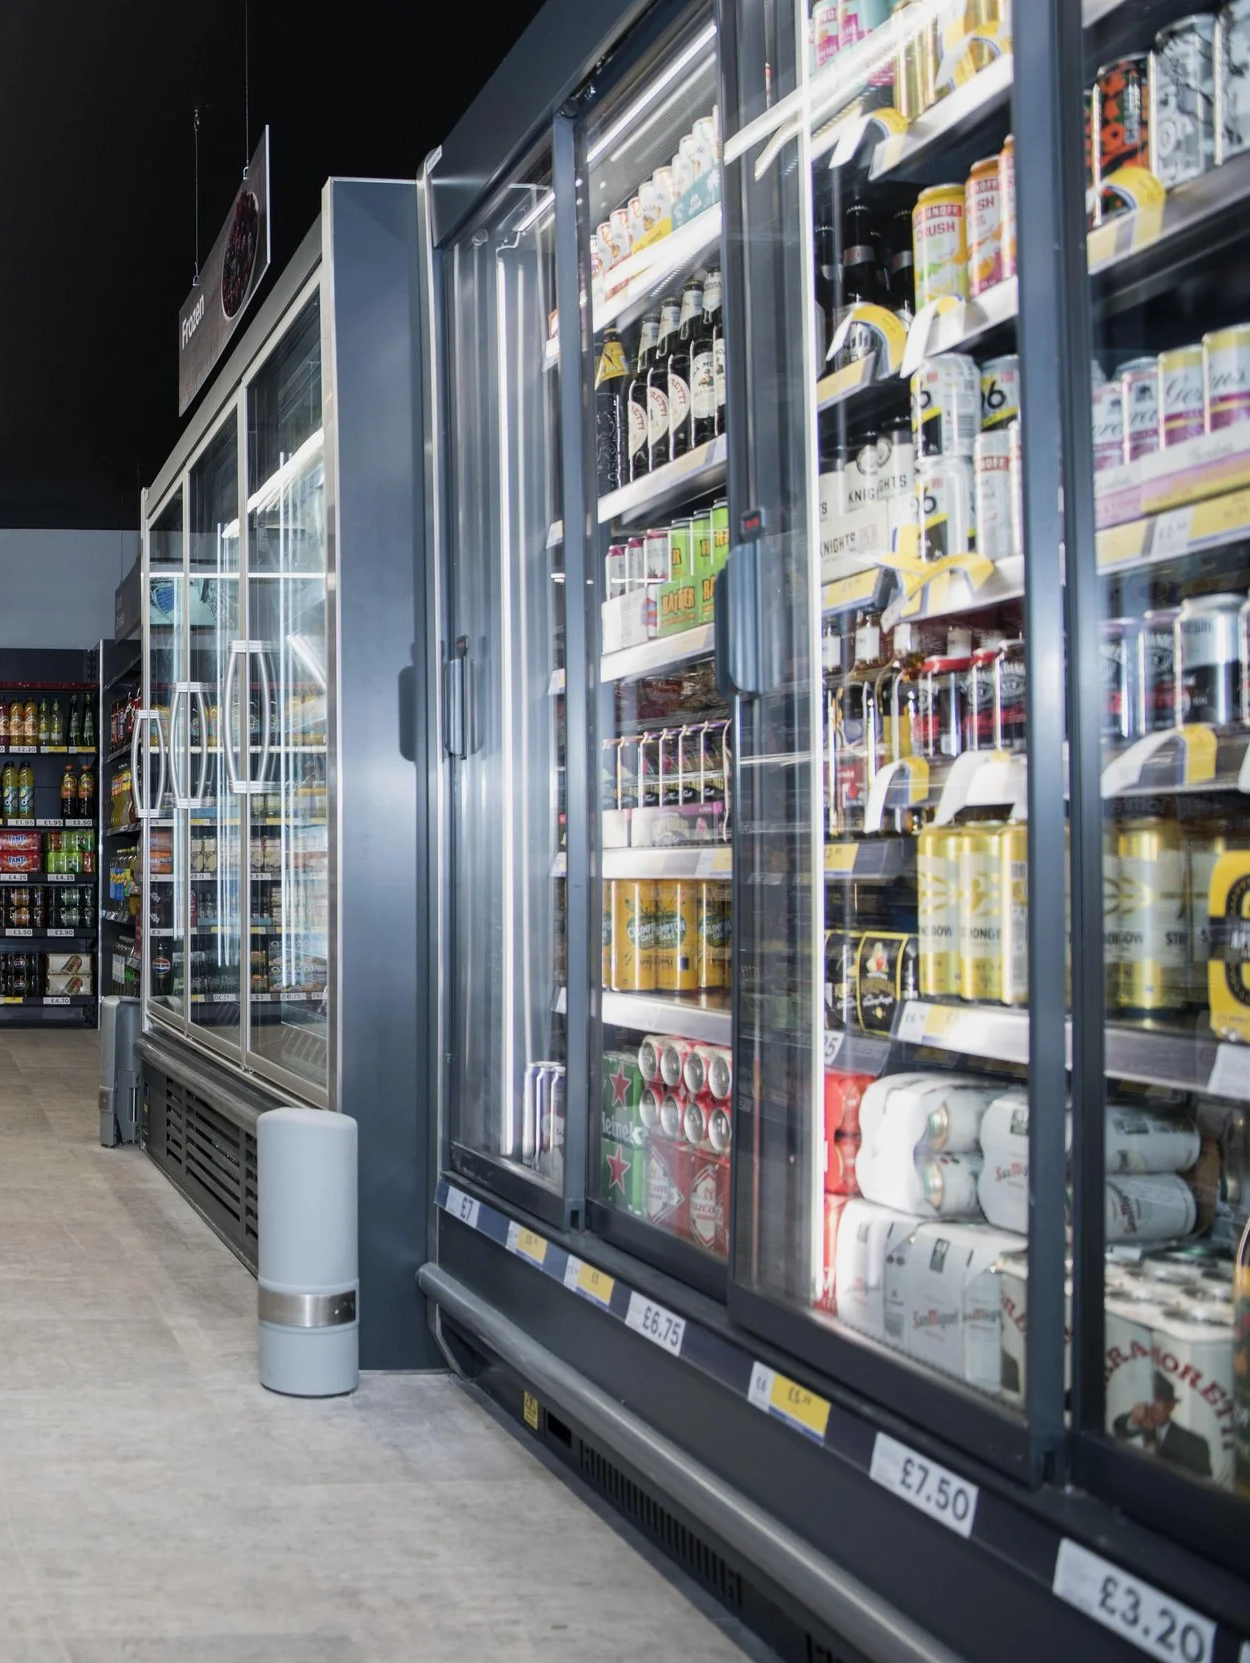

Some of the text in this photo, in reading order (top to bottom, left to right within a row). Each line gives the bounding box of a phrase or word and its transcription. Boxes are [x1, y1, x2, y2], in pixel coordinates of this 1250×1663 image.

[181, 293, 205, 351] Frozen
[459, 1196, 474, 1222] £7
[641, 1305, 682, 1348] £6.75
[899, 1457, 970, 1522] £7.50
[1098, 1573, 1207, 1663] £3.20
